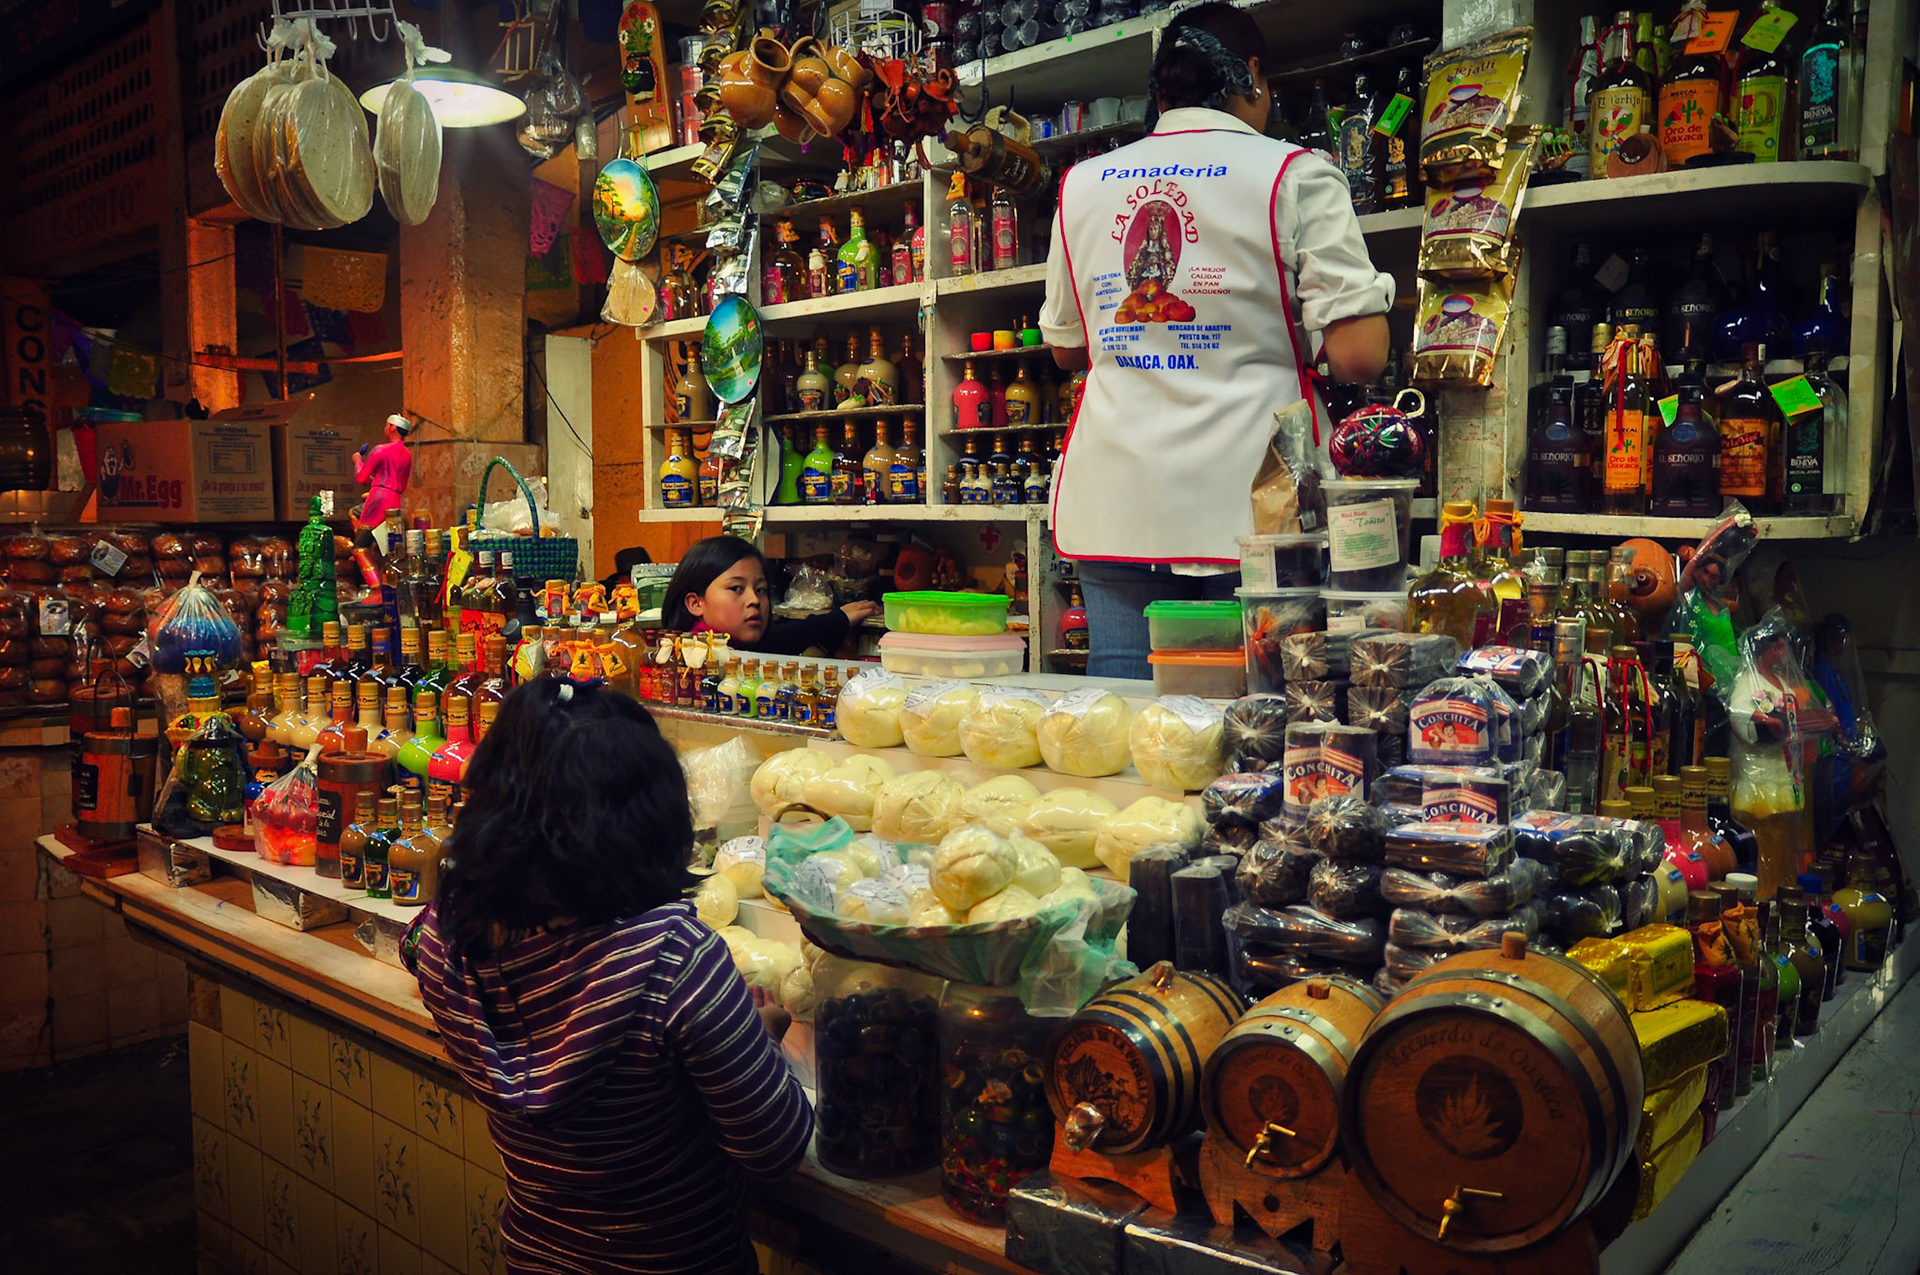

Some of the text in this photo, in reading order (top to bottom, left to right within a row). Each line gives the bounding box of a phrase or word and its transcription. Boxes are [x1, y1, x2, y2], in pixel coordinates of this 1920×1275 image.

[1670, 89, 1698, 97] MEZCAL
[1665, 124, 1702, 136] Oro de
[1663, 133, 1704, 144] Oaxaca
[1101, 164, 1228, 182] Panaderia
[1112, 178, 1199, 245] LA SOLEDAD
[1178, 333, 1200, 341] PUESTO
[1115, 354, 1199, 370] OAXACA, OAX.
[1607, 462, 1640, 470] Oaxaca
[1609, 455, 1639, 463] Oro de
[1418, 713, 1479, 732] CONCHITA
[1286, 761, 1355, 788] CONCHITA
[1422, 803, 1489, 824] CONCHITA
[1385, 1022, 1565, 1120] Recuerdo de Oaxaca
